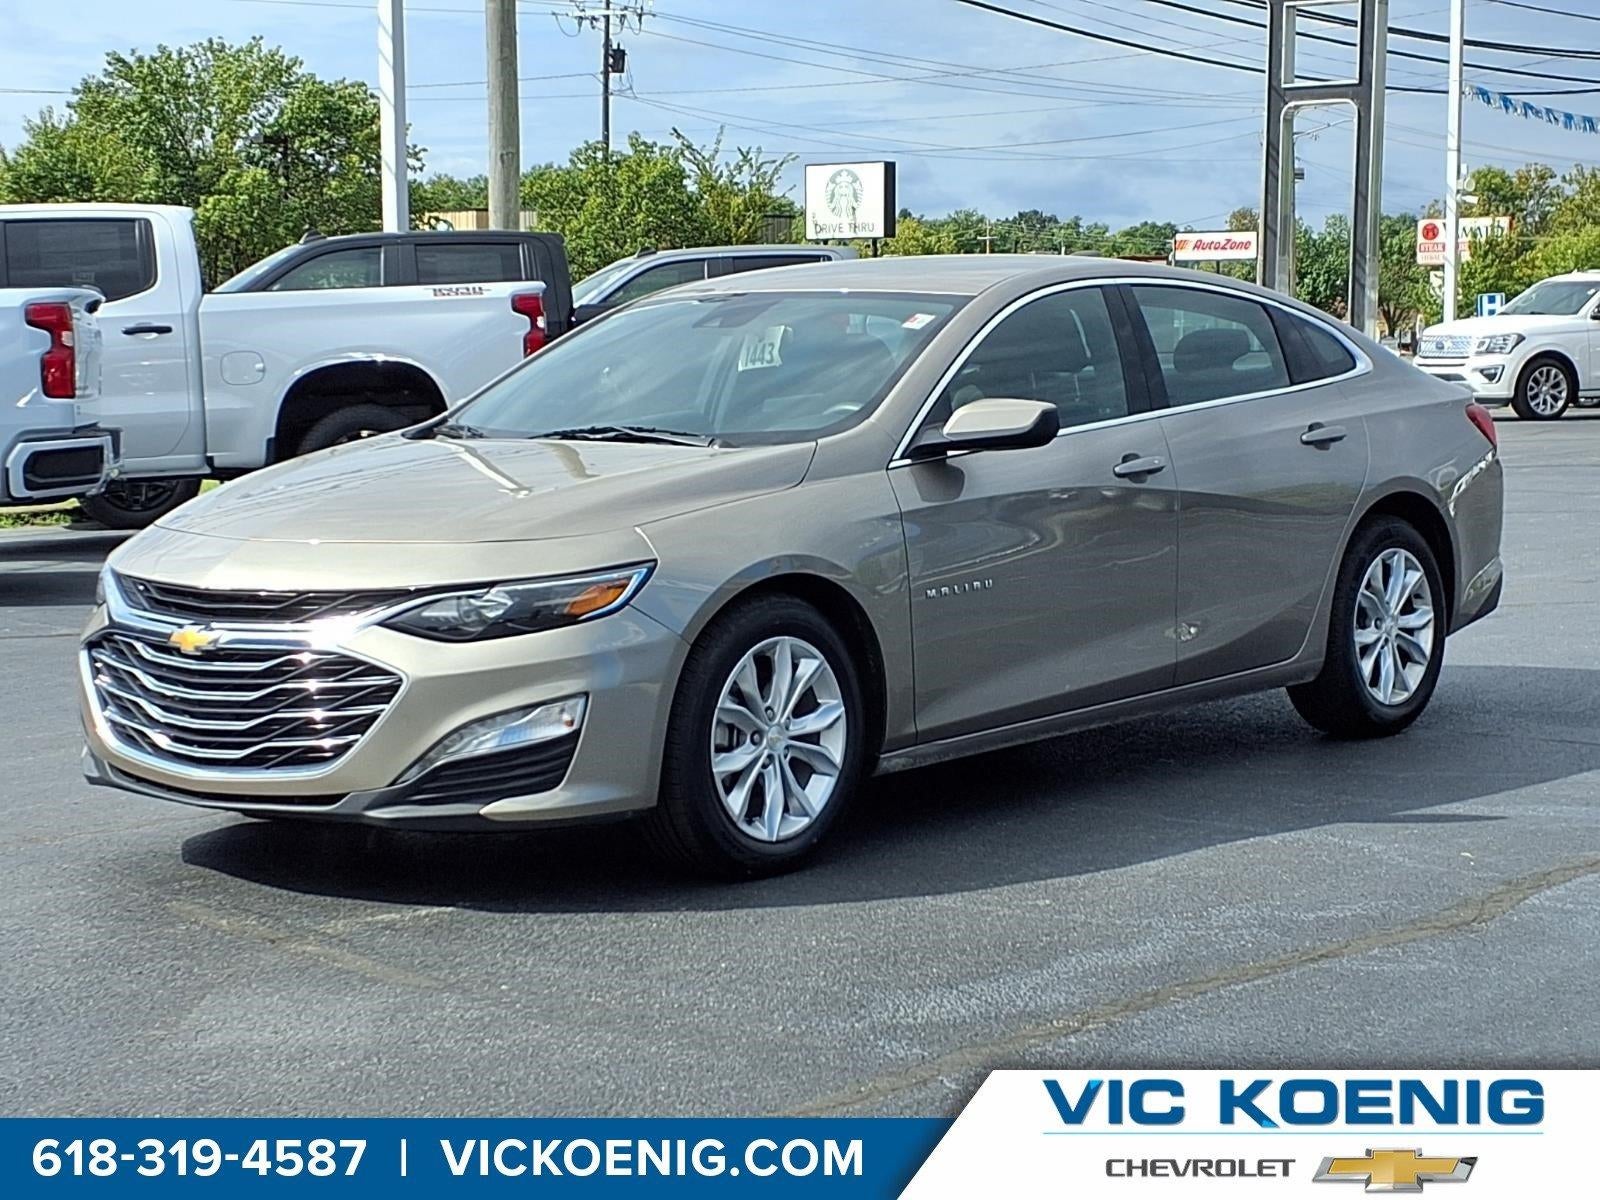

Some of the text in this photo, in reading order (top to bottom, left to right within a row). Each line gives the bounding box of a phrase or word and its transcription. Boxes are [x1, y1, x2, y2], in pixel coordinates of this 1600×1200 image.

[814, 222, 874, 234] DRIVE THRU
[1192, 238, 1252, 251] AutoZone
[925, 578, 993, 599] MALIBU
